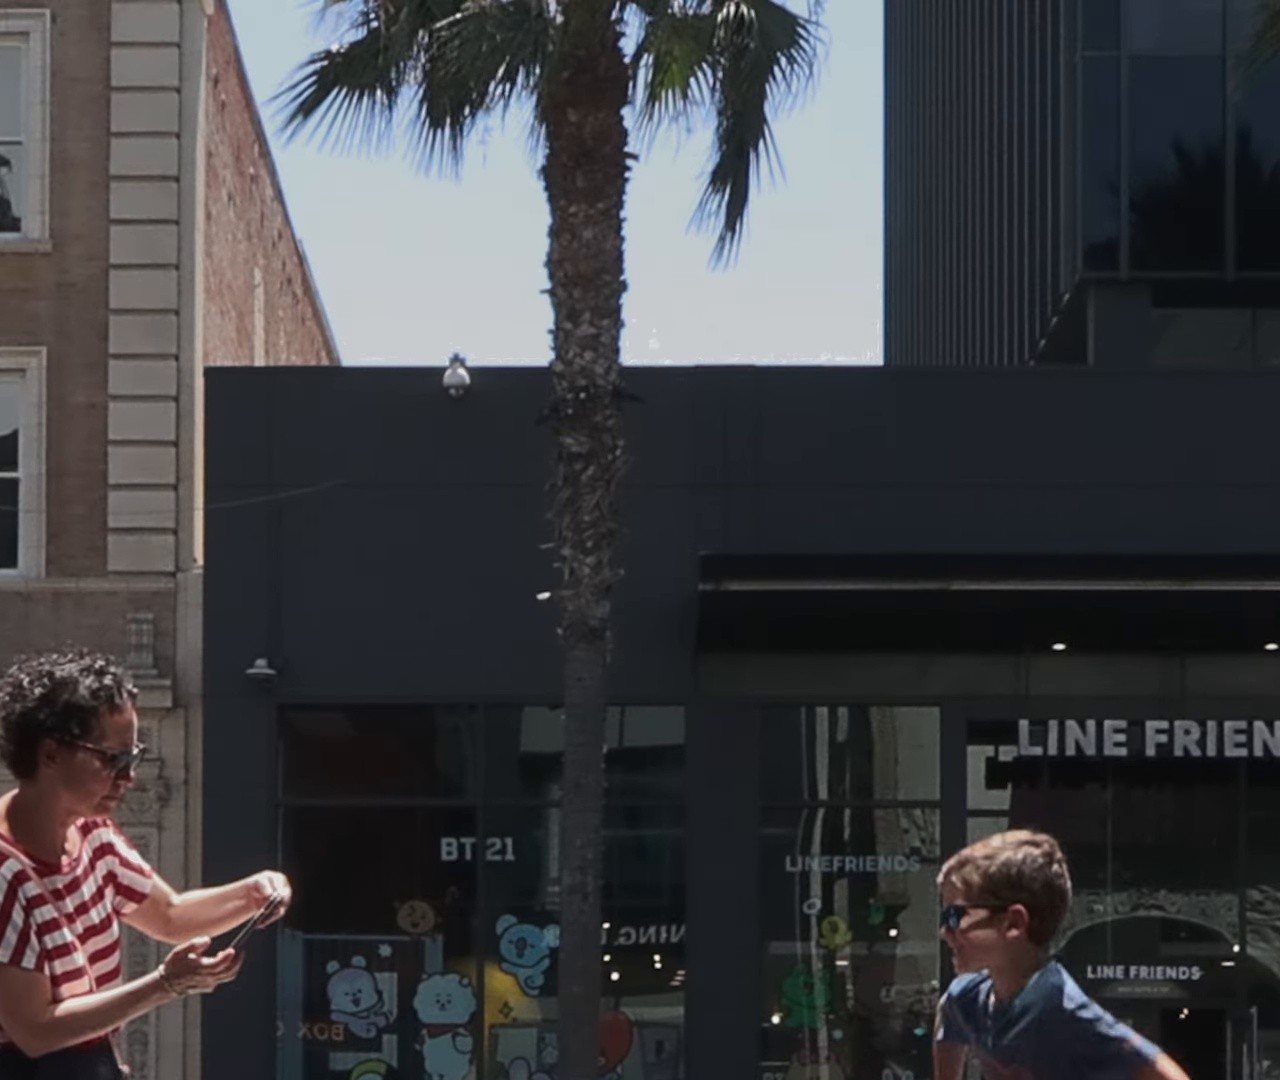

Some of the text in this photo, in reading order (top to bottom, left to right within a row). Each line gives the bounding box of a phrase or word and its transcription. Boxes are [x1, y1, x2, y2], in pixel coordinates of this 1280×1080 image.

[1019, 719, 1128, 756] LINE
[1087, 965, 1201, 980] LINE FRIENDS
